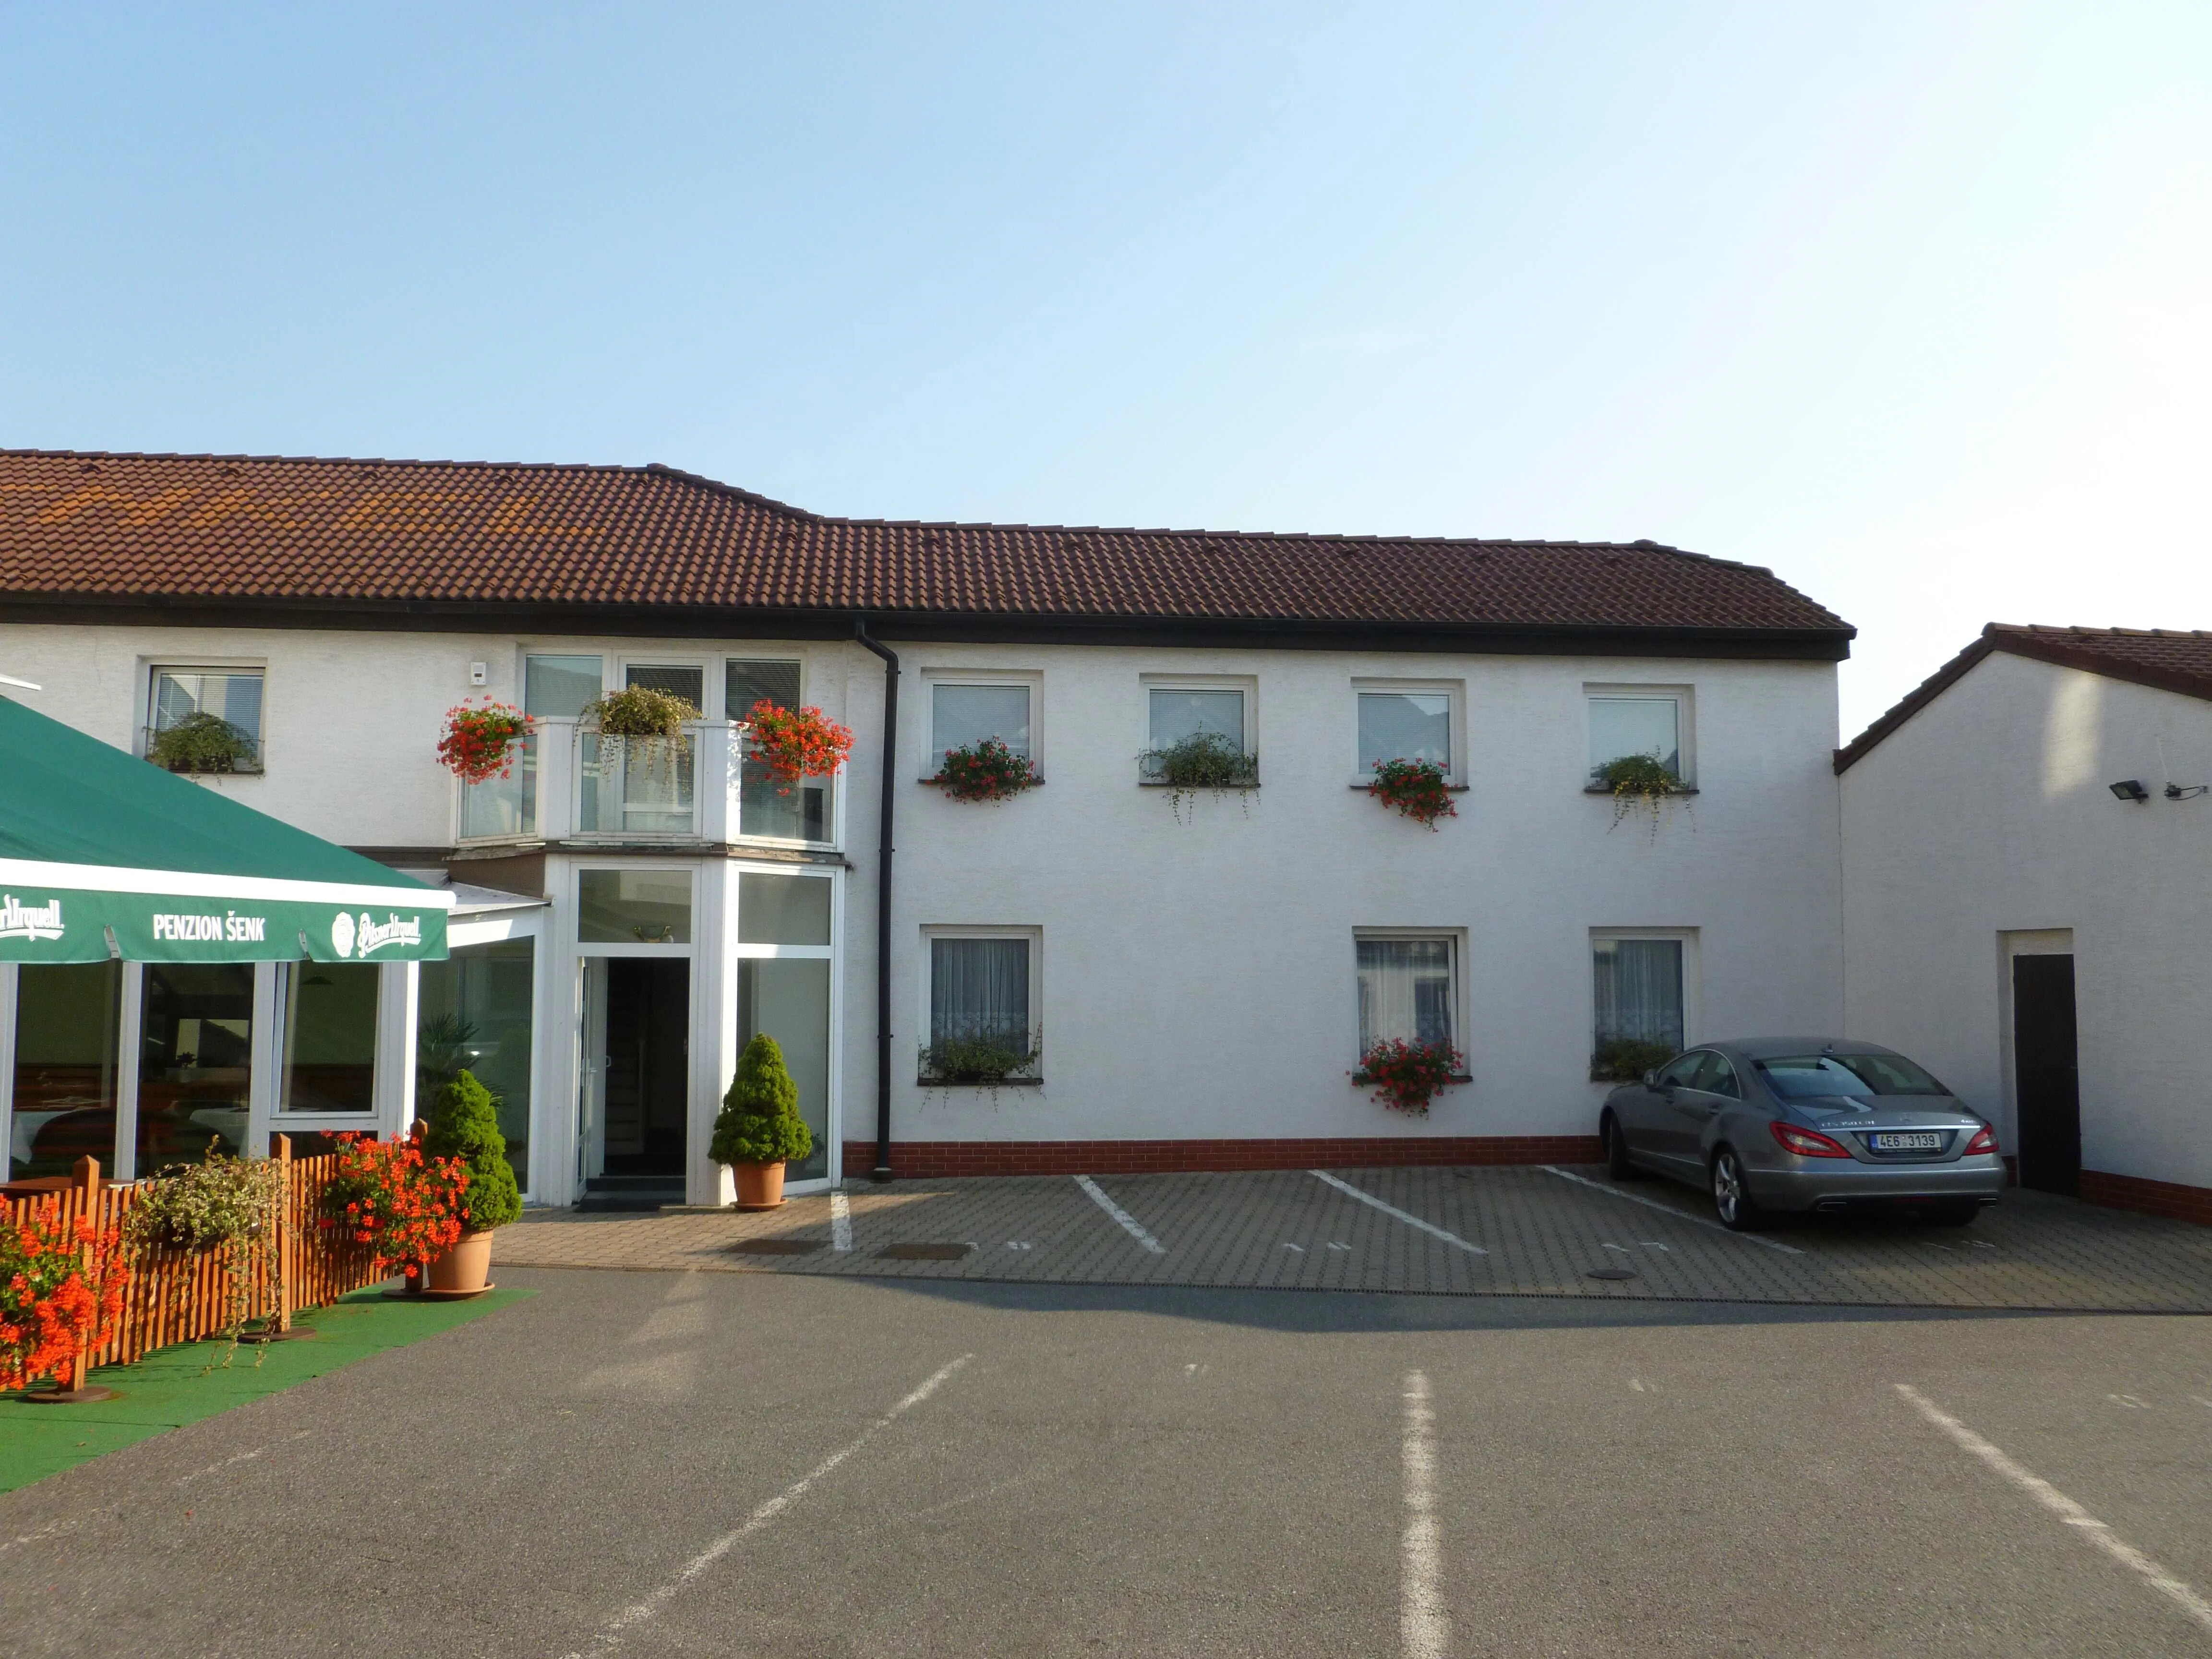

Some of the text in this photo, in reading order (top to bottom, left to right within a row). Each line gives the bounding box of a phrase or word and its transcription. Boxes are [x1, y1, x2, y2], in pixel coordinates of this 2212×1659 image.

[153, 910, 265, 941] PENZION ŠENK
[1880, 1135, 1936, 1147] 4E6 3139
